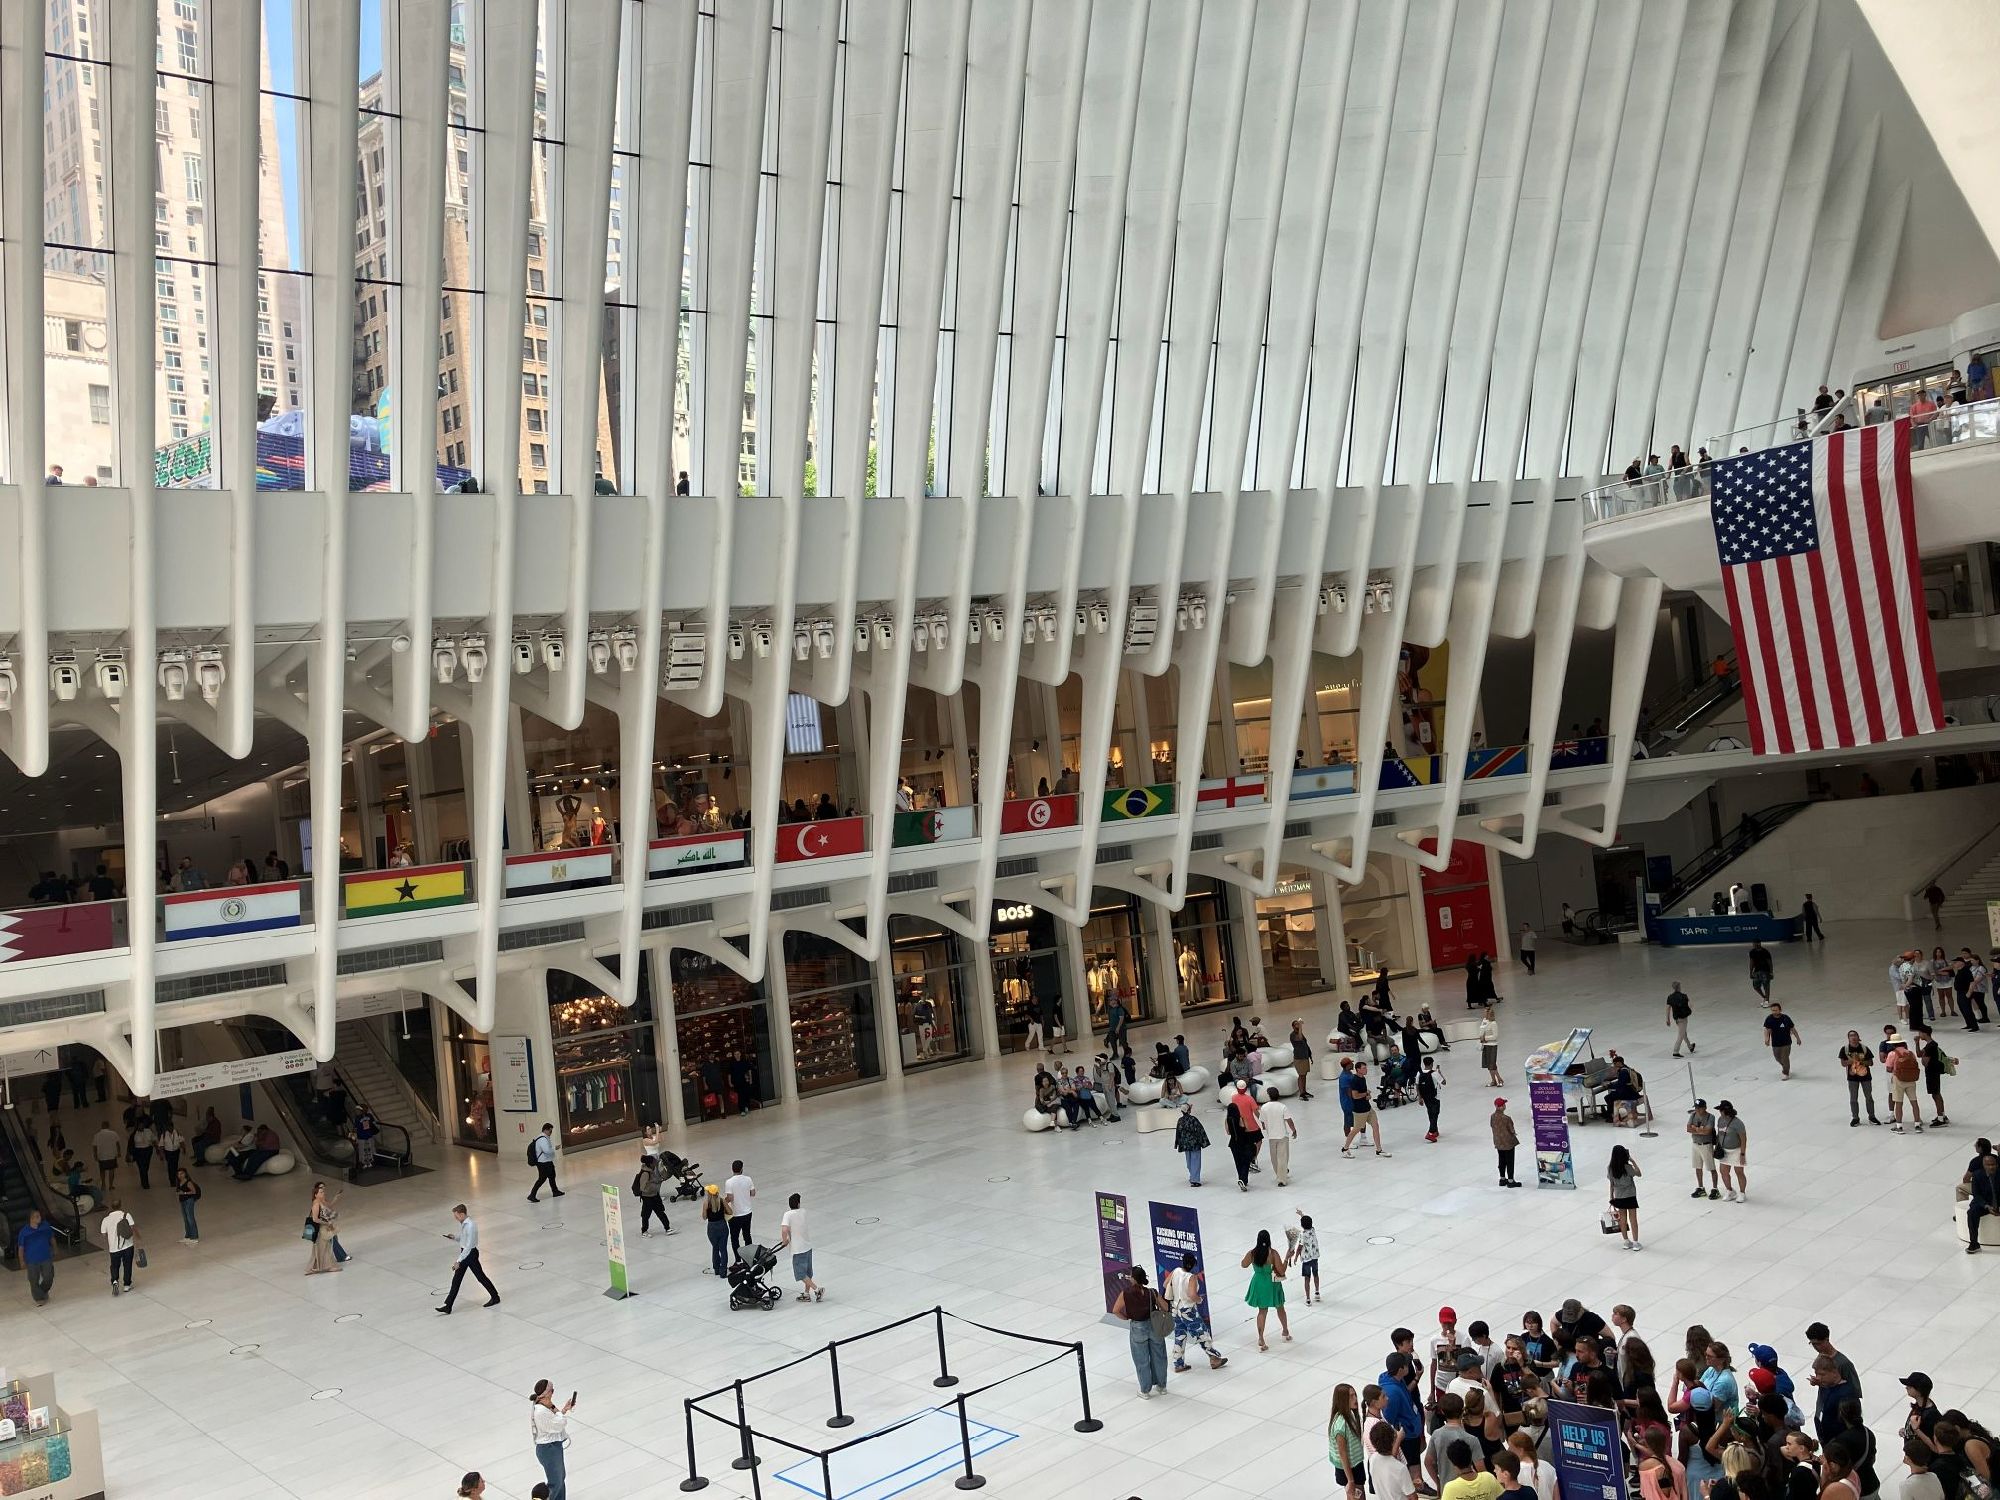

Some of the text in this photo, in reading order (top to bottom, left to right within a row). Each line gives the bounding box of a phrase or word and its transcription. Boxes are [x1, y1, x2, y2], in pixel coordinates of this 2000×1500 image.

[1280, 882, 1310, 894] WEITZMAN
[998, 904, 1034, 922] BOSS
[924, 1024, 950, 1040] SALE
[1156, 1227, 1196, 1242] KICKING OFF THE
[1157, 1236, 1198, 1252] SUMMER GAMES
[1562, 1424, 1606, 1446] HELP US
[1593, 1453, 1608, 1461] BETTER
